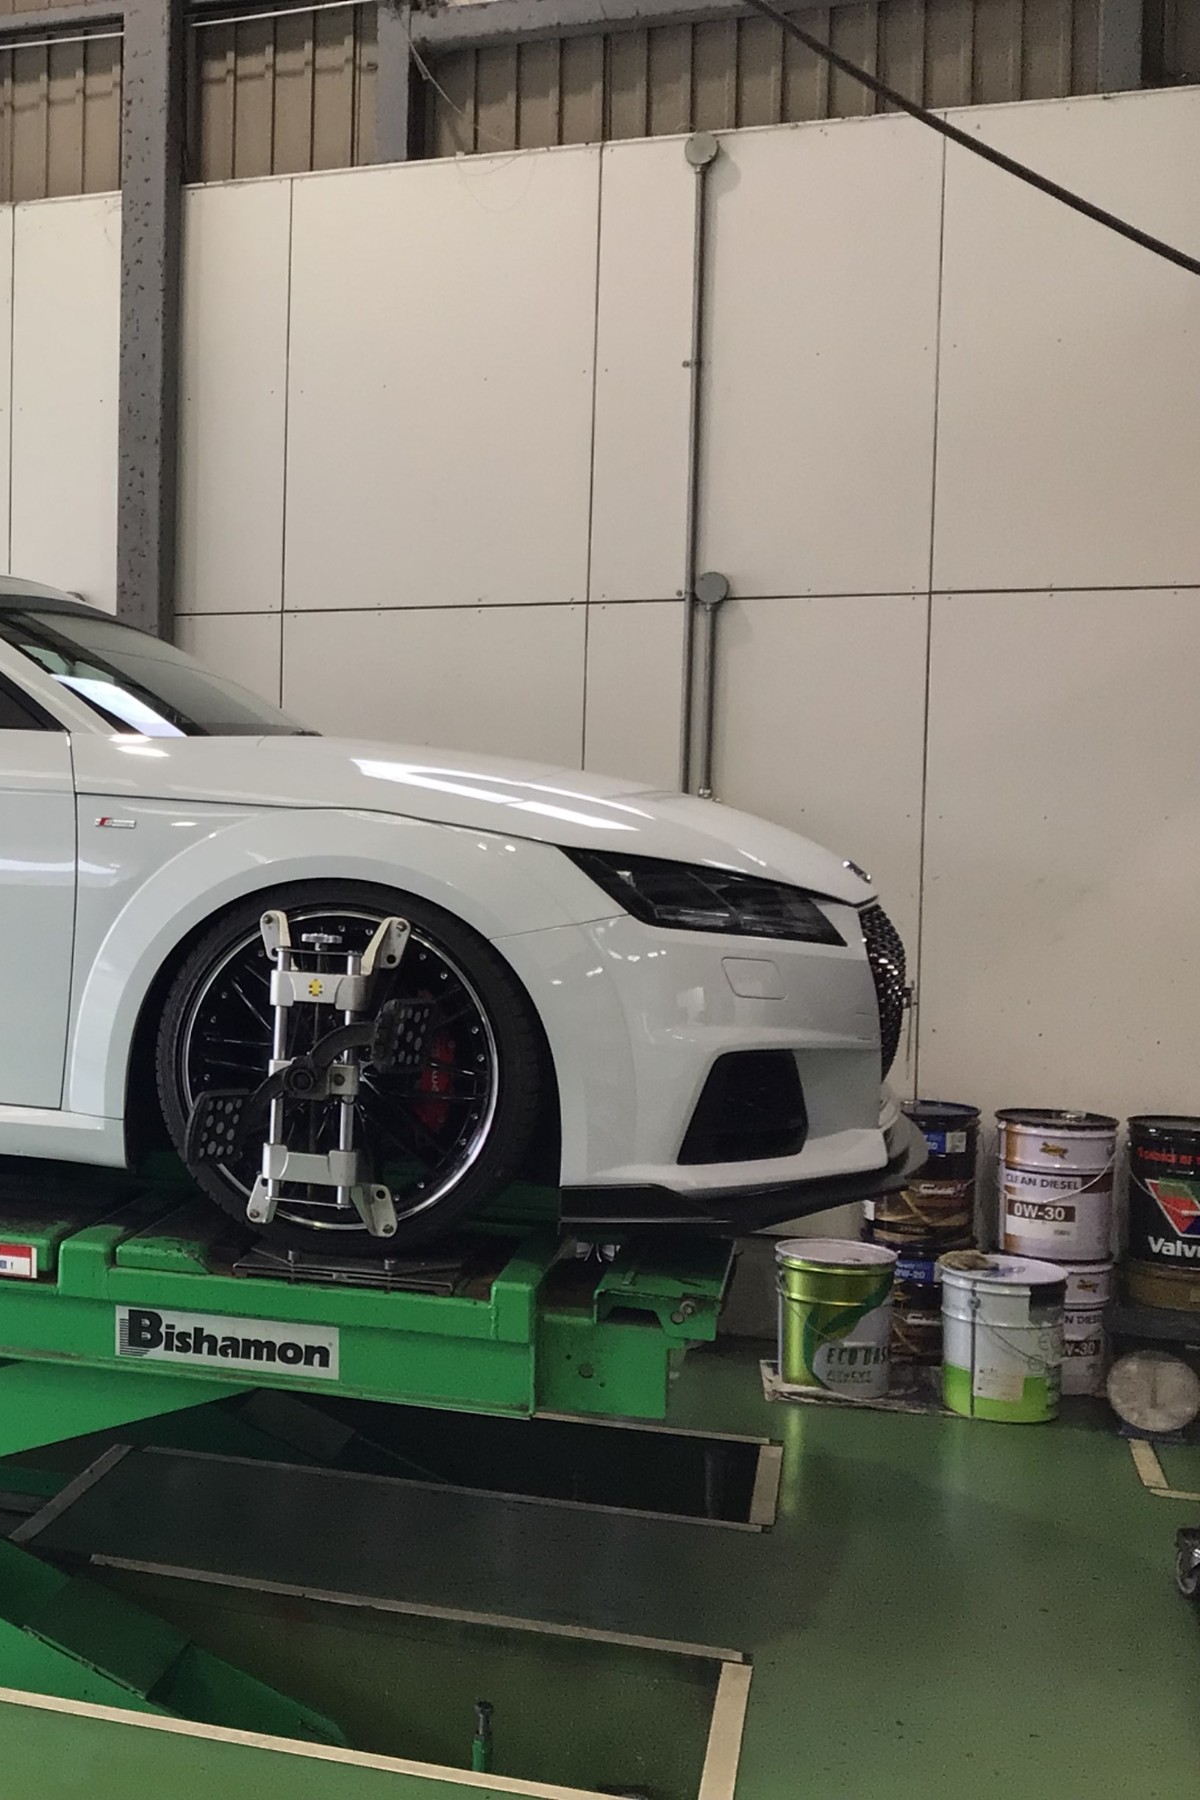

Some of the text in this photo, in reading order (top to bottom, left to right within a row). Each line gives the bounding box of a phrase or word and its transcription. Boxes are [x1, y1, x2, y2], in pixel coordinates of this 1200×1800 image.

[1005, 1173, 1080, 1191] CLEAN DIESEL
[1013, 1202, 1066, 1221] 0W-30
[1148, 1236, 1200, 1258] Valv
[127, 1309, 330, 1368] Bishamon
